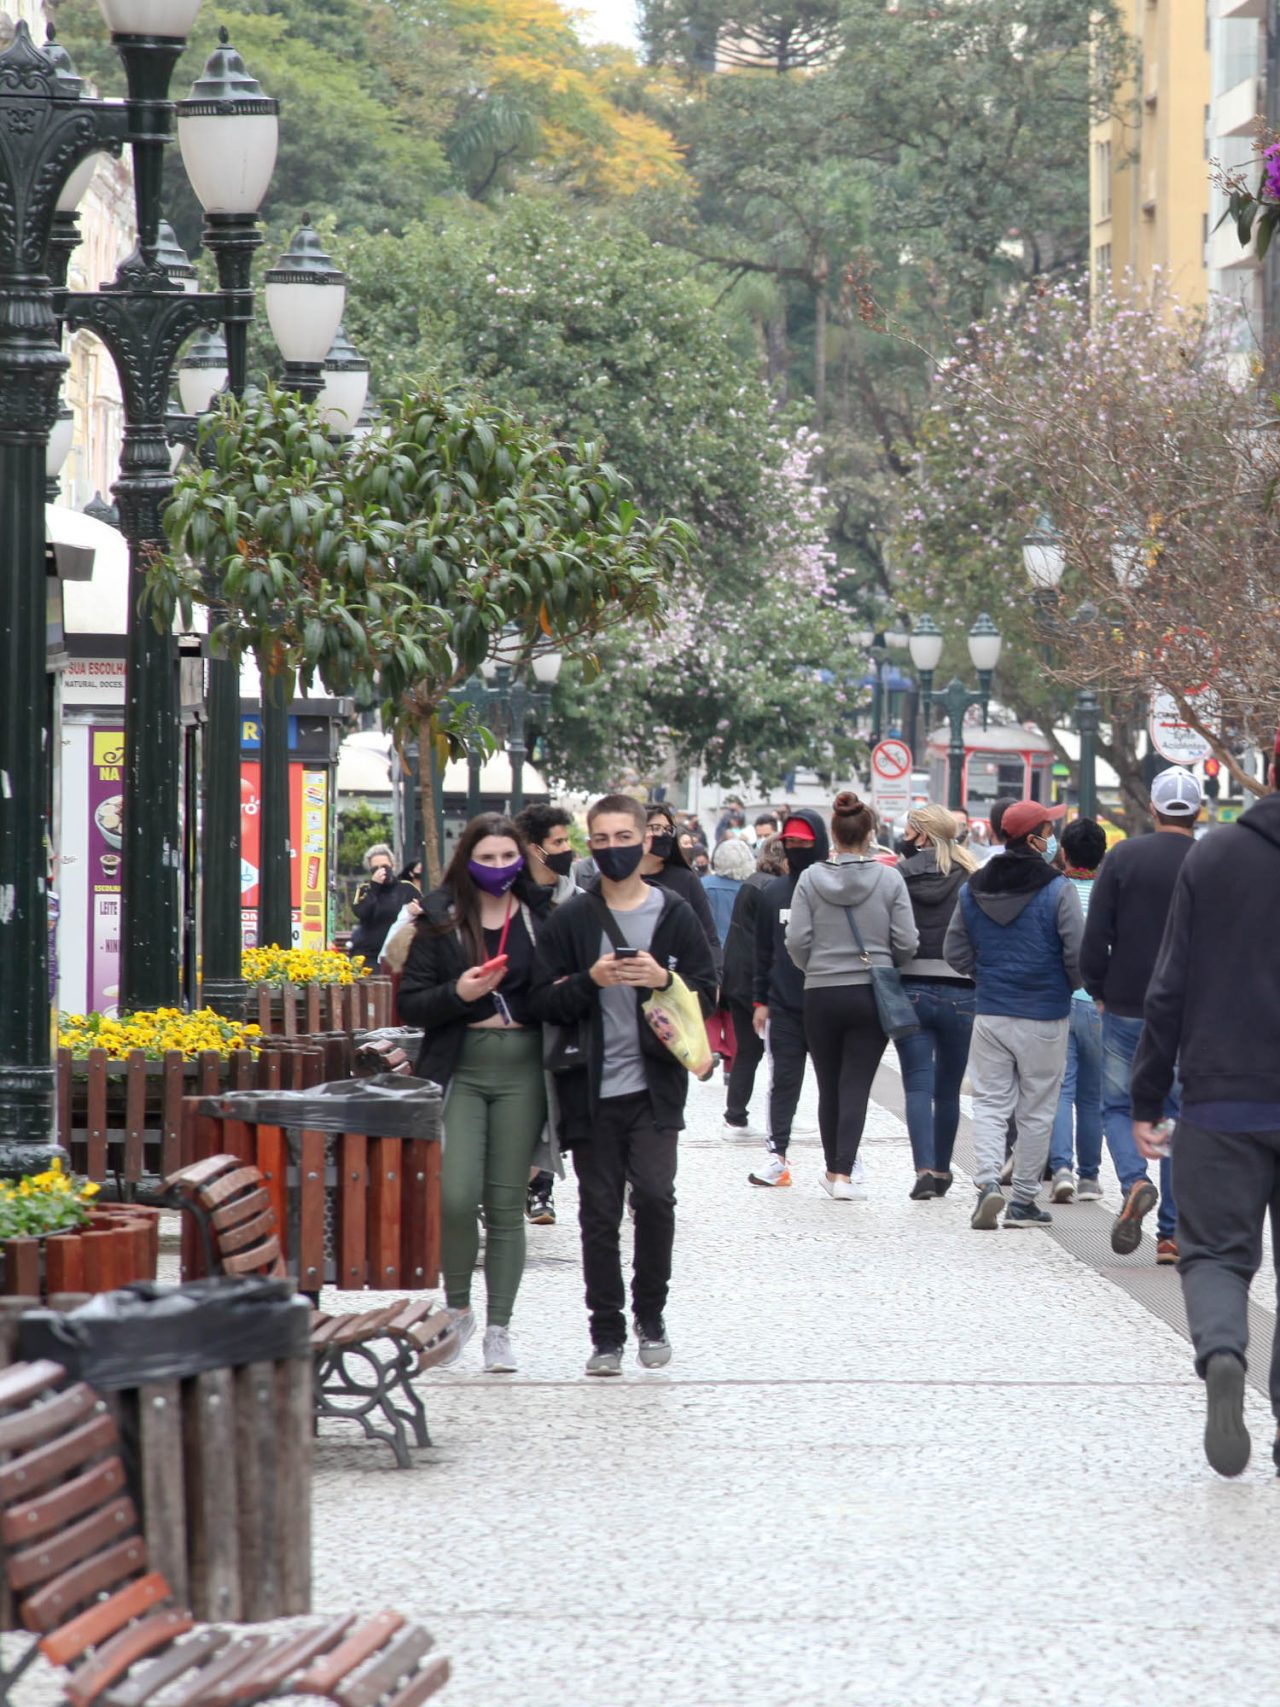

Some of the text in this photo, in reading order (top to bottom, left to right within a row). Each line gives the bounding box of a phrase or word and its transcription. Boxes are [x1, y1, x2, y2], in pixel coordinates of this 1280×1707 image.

[69, 662, 86, 674] SUA
[100, 901, 118, 915] LEITE
[105, 939, 119, 953] NIN
